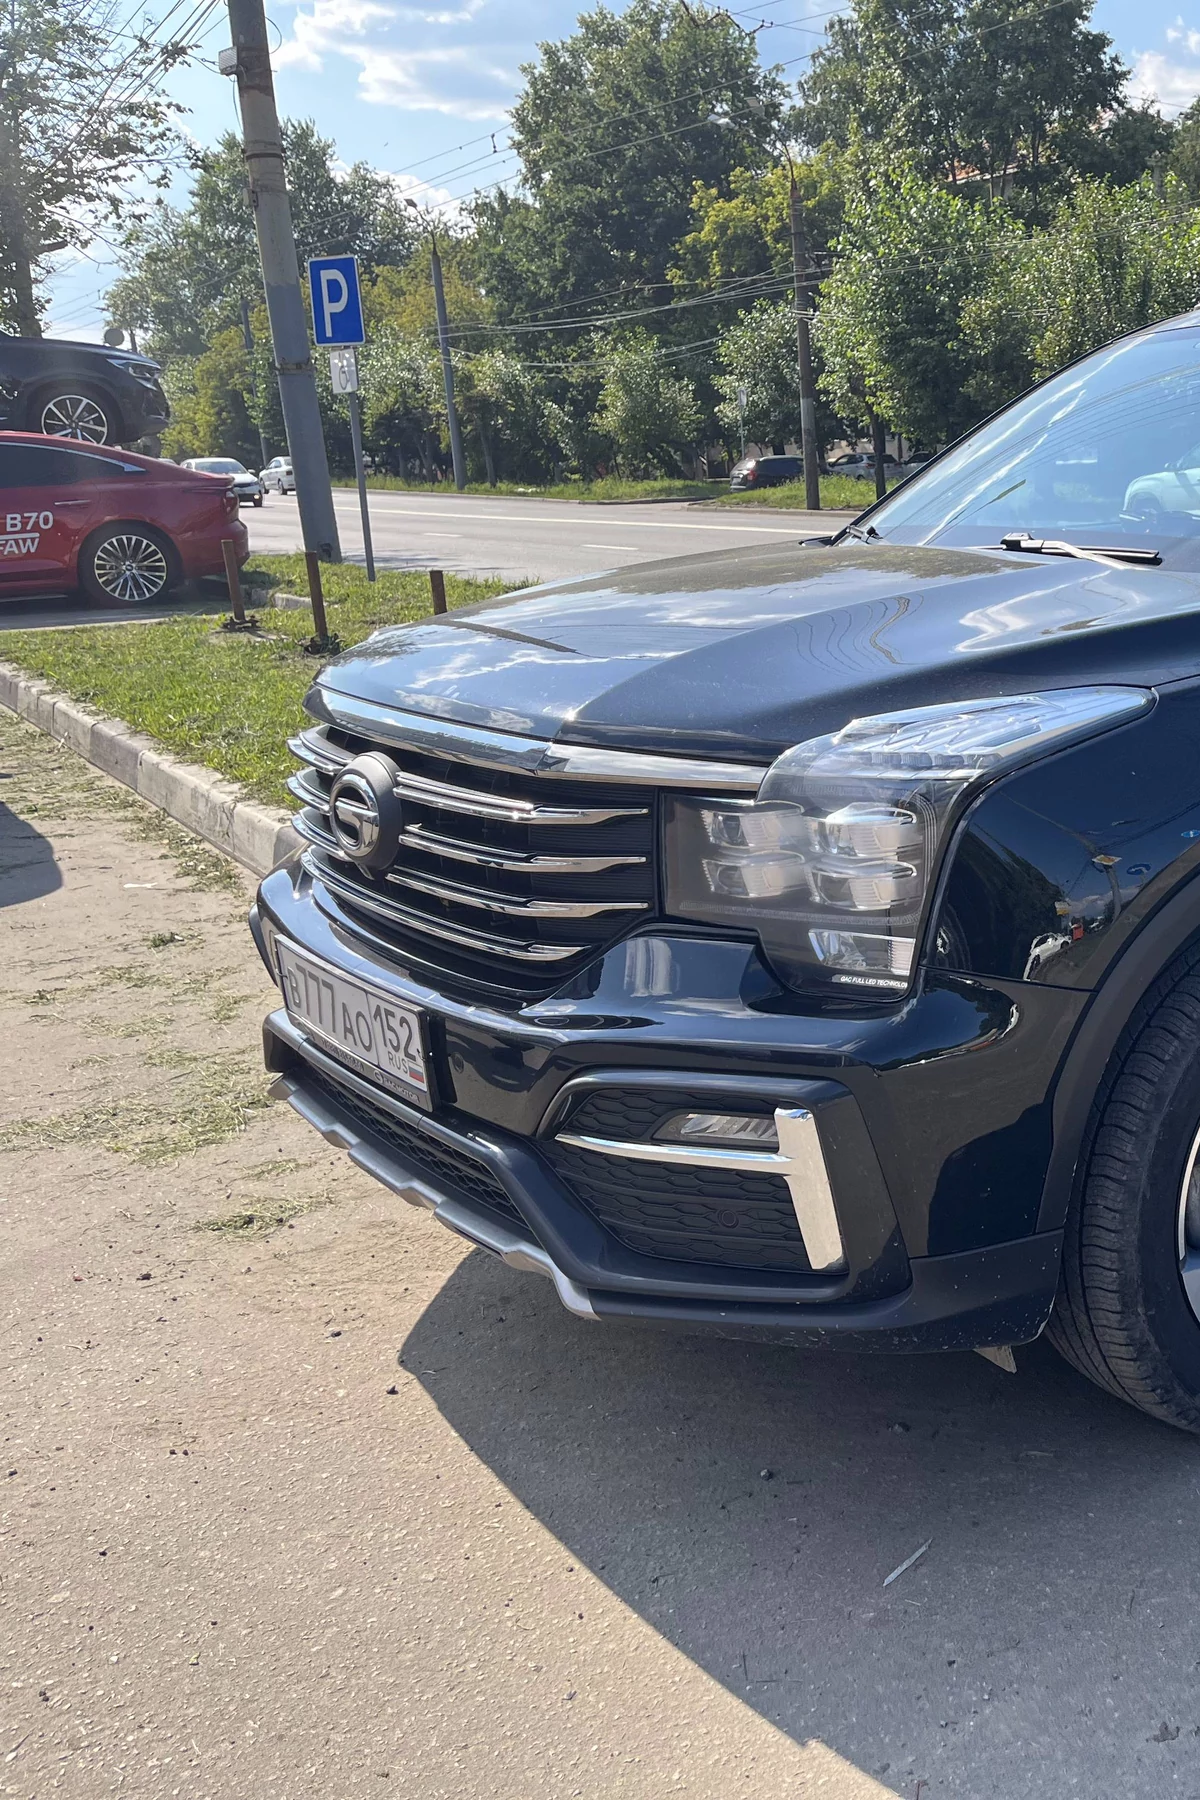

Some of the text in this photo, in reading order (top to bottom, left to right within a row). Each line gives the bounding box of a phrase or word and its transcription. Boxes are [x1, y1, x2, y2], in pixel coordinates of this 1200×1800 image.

[320, 269, 348, 337] P
[6, 511, 54, 532] B70
[374, 1004, 417, 1061] 152
[388, 1051, 408, 1074] RUS
